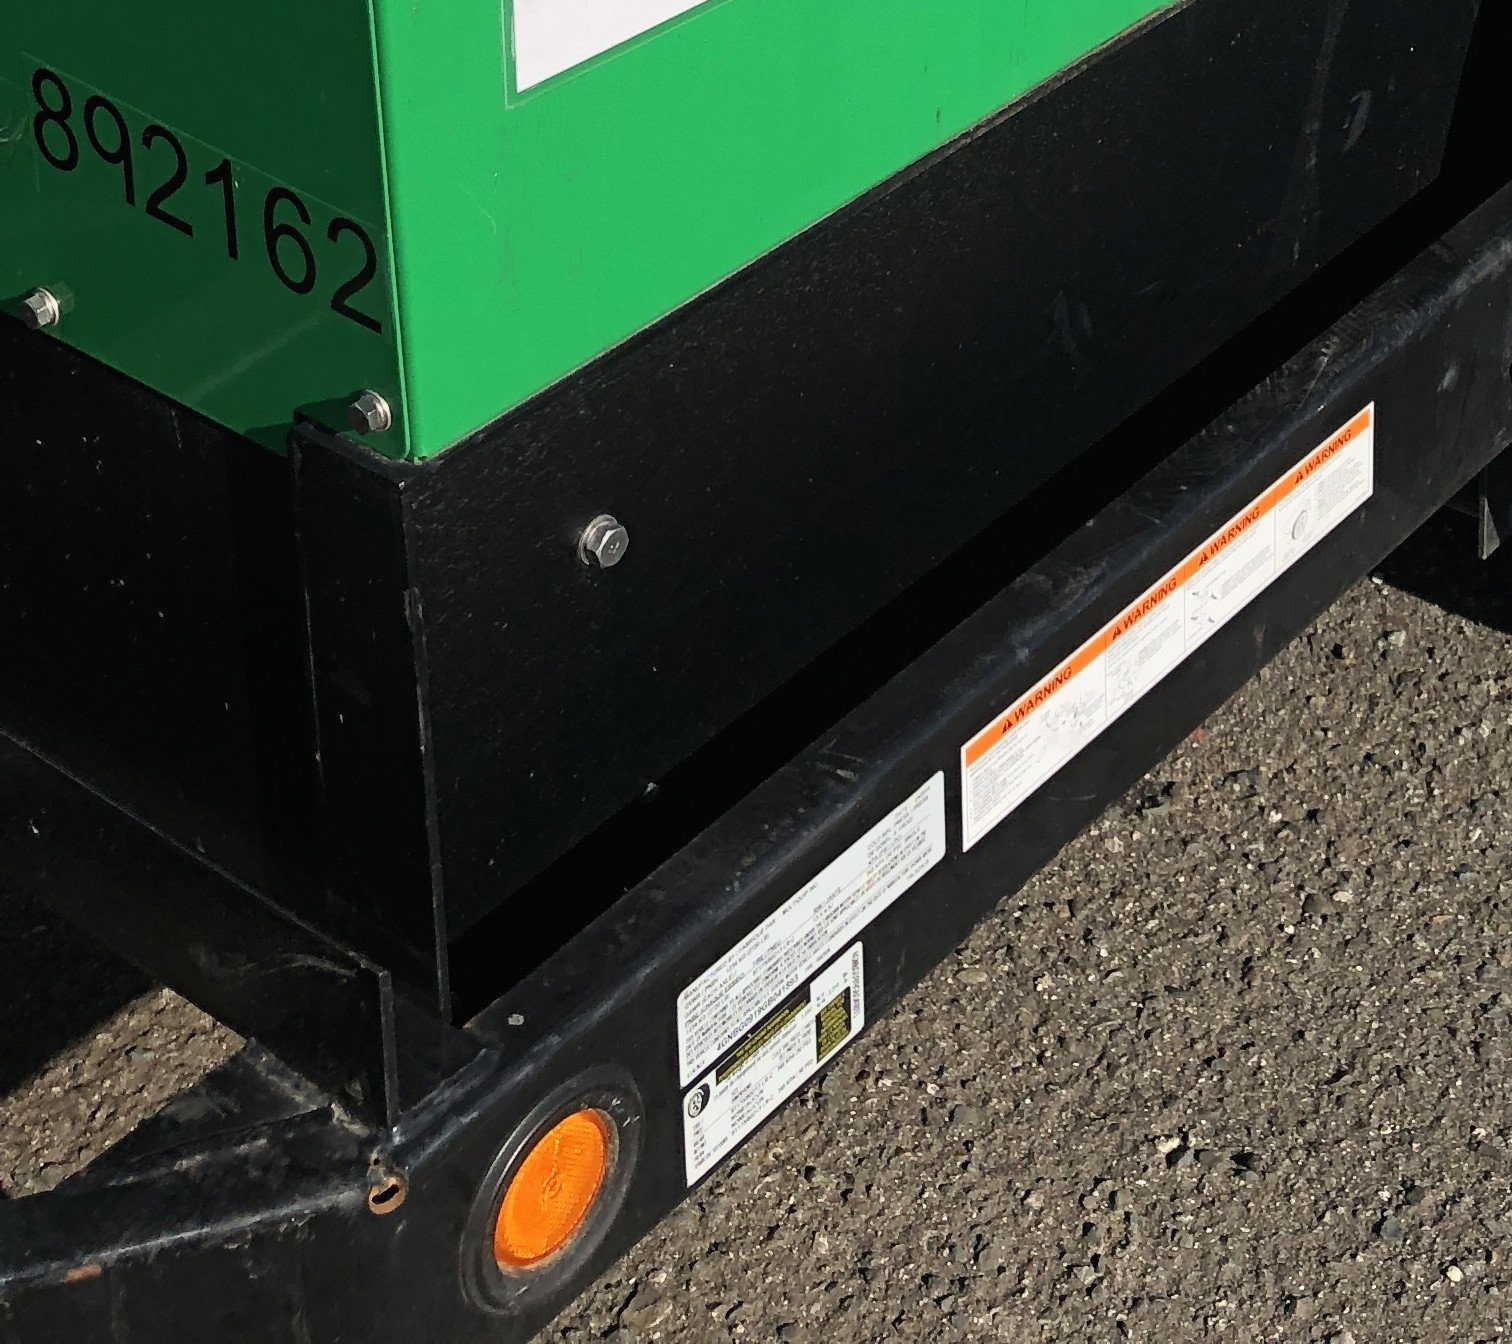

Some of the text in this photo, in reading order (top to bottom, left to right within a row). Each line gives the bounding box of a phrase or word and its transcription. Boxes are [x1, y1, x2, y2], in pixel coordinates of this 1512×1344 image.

[30, 67, 384, 336] 892162
[1303, 428, 1353, 474] WARNING
[1208, 507, 1261, 556] WARNING
[1122, 577, 1178, 627] WARNING
[1014, 666, 1073, 722] WARNING
